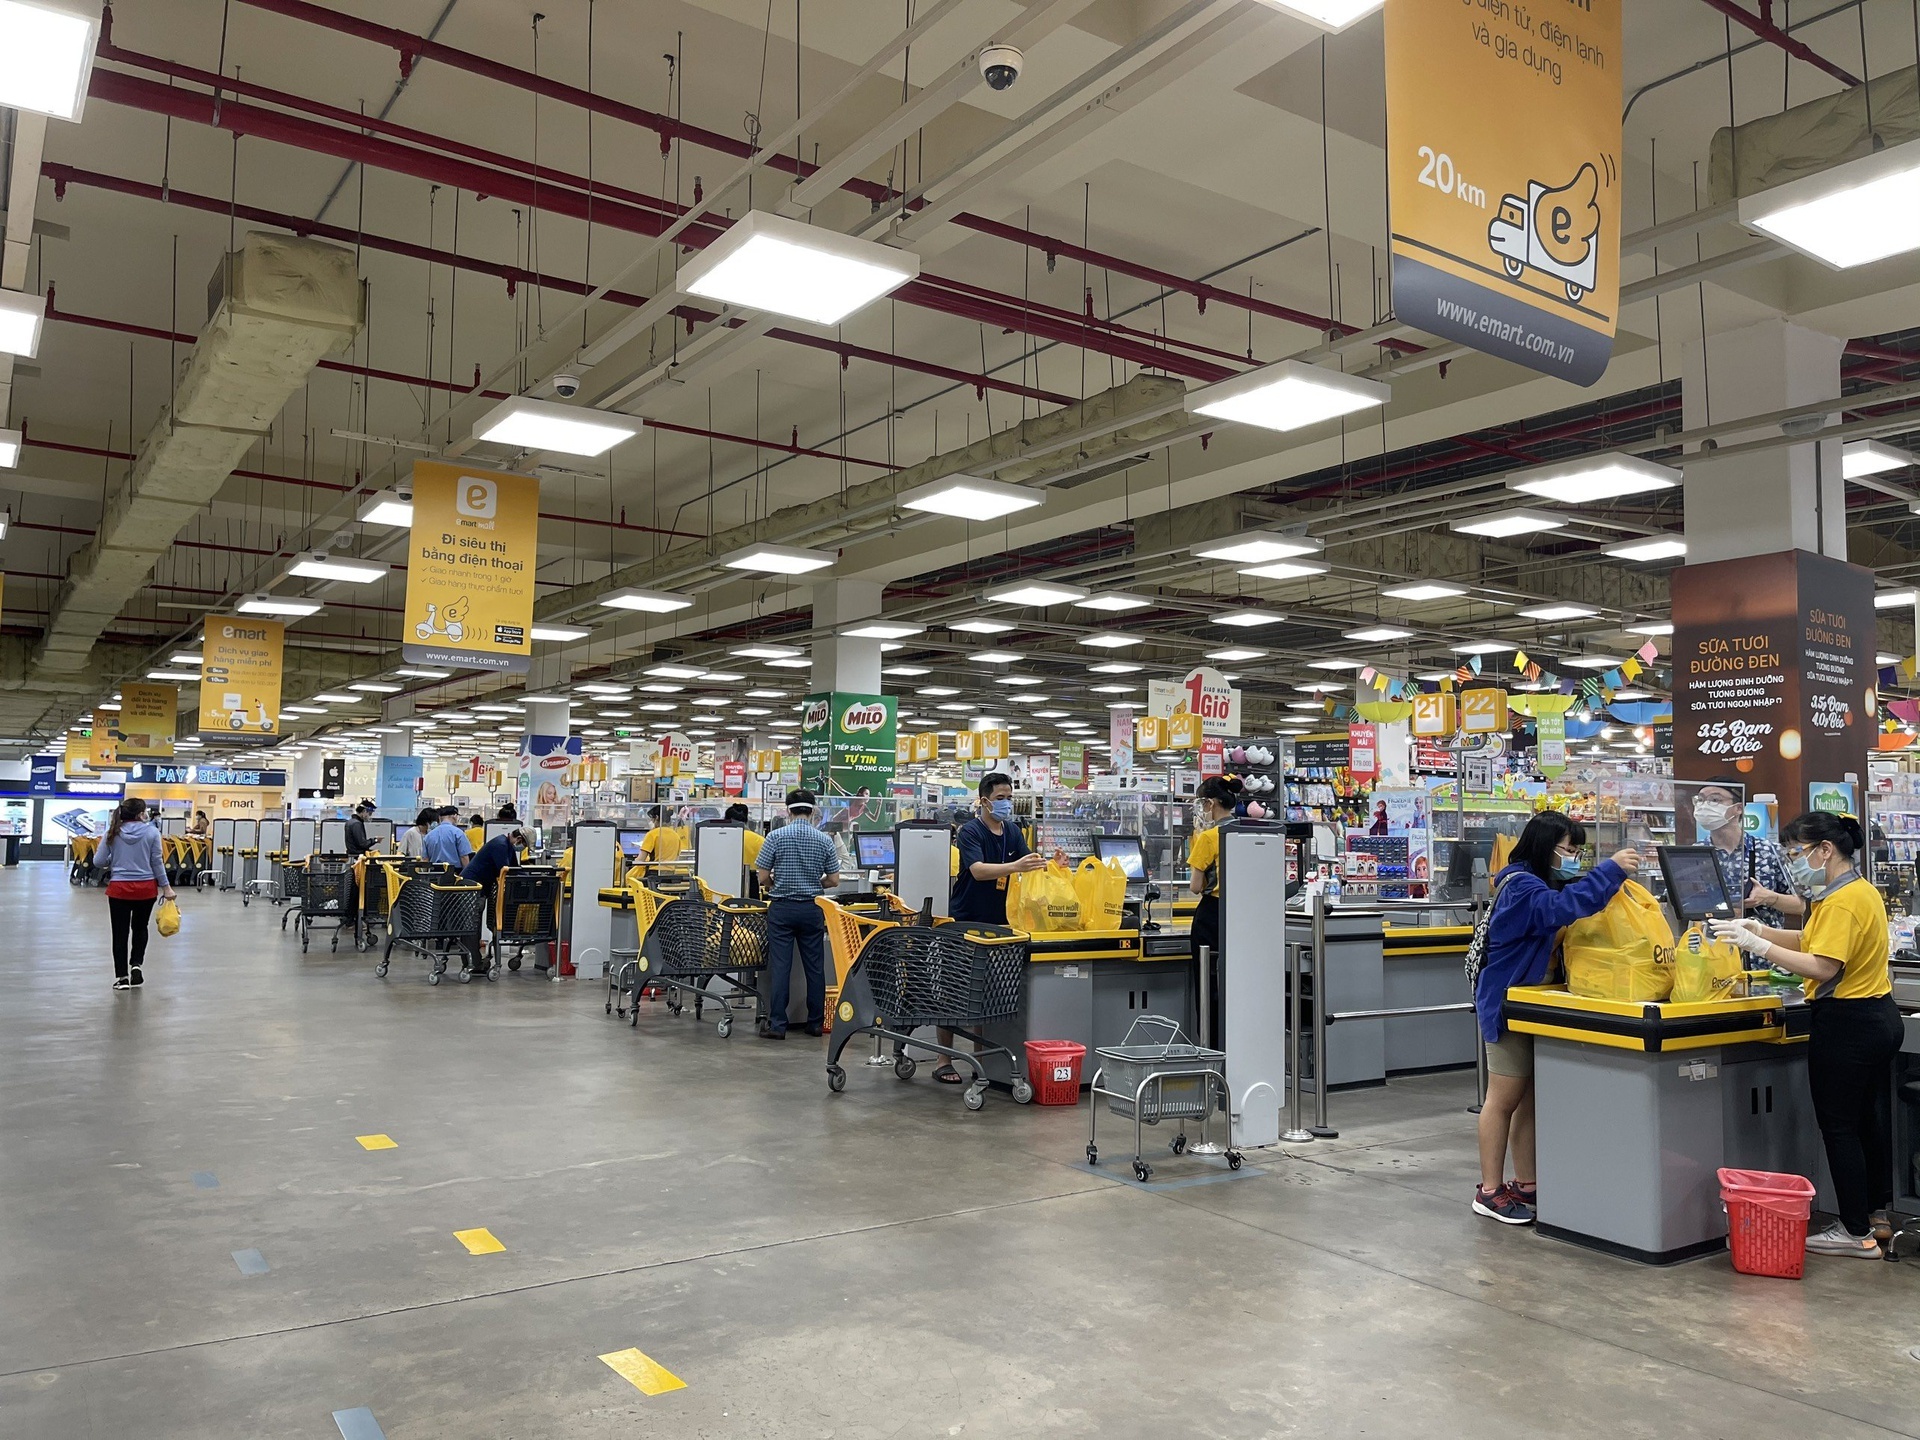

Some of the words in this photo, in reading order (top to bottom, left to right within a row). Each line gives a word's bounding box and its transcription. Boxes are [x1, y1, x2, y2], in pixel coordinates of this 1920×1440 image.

[1472, 21, 1490, 47] và
[1494, 34, 1518, 59] gia
[1522, 45, 1561, 85] dụng
[1539, 20, 1571, 52] điện
[1576, 35, 1604, 69] lạnh
[1417, 145, 1454, 194] 20
[1456, 173, 1486, 209] km
[1437, 297, 1575, 365] www.emart.com.vn
[456, 518, 477, 528] emart
[442, 533, 456, 545] Đi
[460, 536, 486, 550] siêu
[490, 541, 506, 555] thị
[422, 546, 455, 564] bằng
[459, 553, 487, 568] điện
[491, 557, 523, 574] thoại
[430, 565, 447, 575] Giao
[449, 569, 471, 578] nhanh
[473, 572, 492, 582] trong
[429, 577, 446, 587] Giao
[447, 579, 467, 590] hàng
[1810, 609, 1826, 625] SỮA
[1827, 613, 1846, 629] TƯƠI
[222, 626, 267, 641] emart
[1805, 628, 1834, 646] ĐƯỜNG
[1835, 634, 1851, 649] ĐEN
[1699, 638, 1729, 654] SỮA
[1732, 635, 1769, 651] TƯƠI
[251, 649, 269, 658] giao
[426, 652, 509, 667] www.emart.com.vn
[1690, 656, 1744, 673] ĐƯỜNG
[1748, 653, 1779, 669] ĐEN
[1689, 680, 1706, 689] HÀM
[1708, 678, 1734, 688] LƯỢNG
[1735, 677, 1754, 686] DINH
[1755, 674, 1784, 684] DƯỠNG
[1185, 673, 1203, 714] 1
[1708, 690, 1735, 698] TƯƠNG
[1736, 688, 1765, 697] ĐƯƠNG
[1201, 694, 1231, 719] Giờ
[1418, 696, 1440, 718] 21
[1464, 694, 1495, 716] 22
[1691, 701, 1707, 710] SỮA
[1707, 700, 1726, 709] TƯƠI
[1727, 699, 1751, 709] NGOẠI
[1753, 696, 1775, 708] NHẬP
[808, 710, 829, 728] MILO
[852, 711, 883, 725] MILO
[1171, 718, 1190, 735] 20
[1140, 719, 1155, 737] 19
[1351, 729, 1374, 738] KHUYẾN
[1728, 720, 1773, 737] Đạm
[834, 743, 849, 751] TIẾP
[849, 743, 864, 752] SỨC
[917, 735, 927, 749] 16
[959, 734, 970, 749] 17
[984, 732, 998, 748] 18
[1731, 736, 1763, 753] Béo
[844, 753, 860, 765] TỰ
[860, 755, 877, 764] TIN
[156, 768, 187, 782] PAY
[198, 768, 260, 784] SERVICE
[222, 799, 255, 809] emart
[1056, 1068, 1069, 1080] 23
